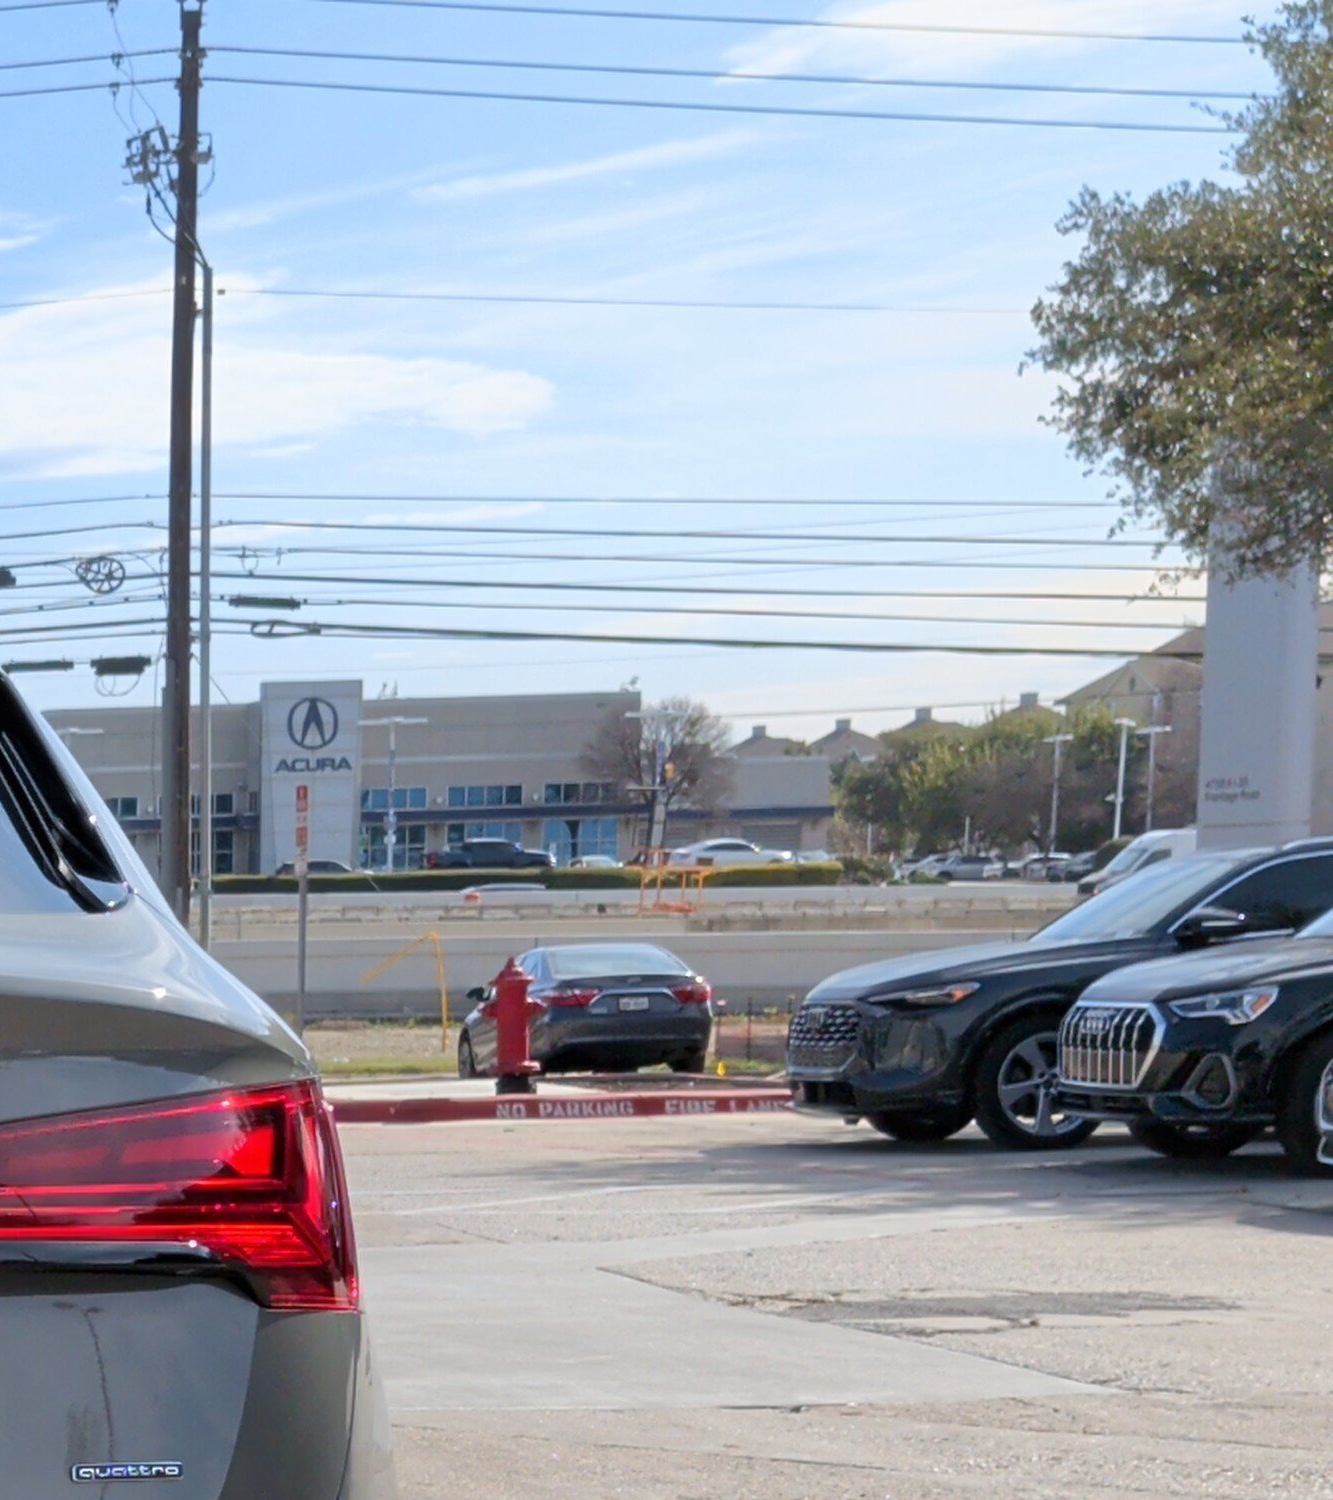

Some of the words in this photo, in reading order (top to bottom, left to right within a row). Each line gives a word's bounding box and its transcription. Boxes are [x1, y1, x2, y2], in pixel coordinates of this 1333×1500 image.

[275, 757, 352, 773] ACURA
[495, 1103, 526, 1118] NO
[538, 1100, 633, 1117] PARKING
[664, 1099, 715, 1114] FIRE
[79, 1465, 180, 1480] quattro
